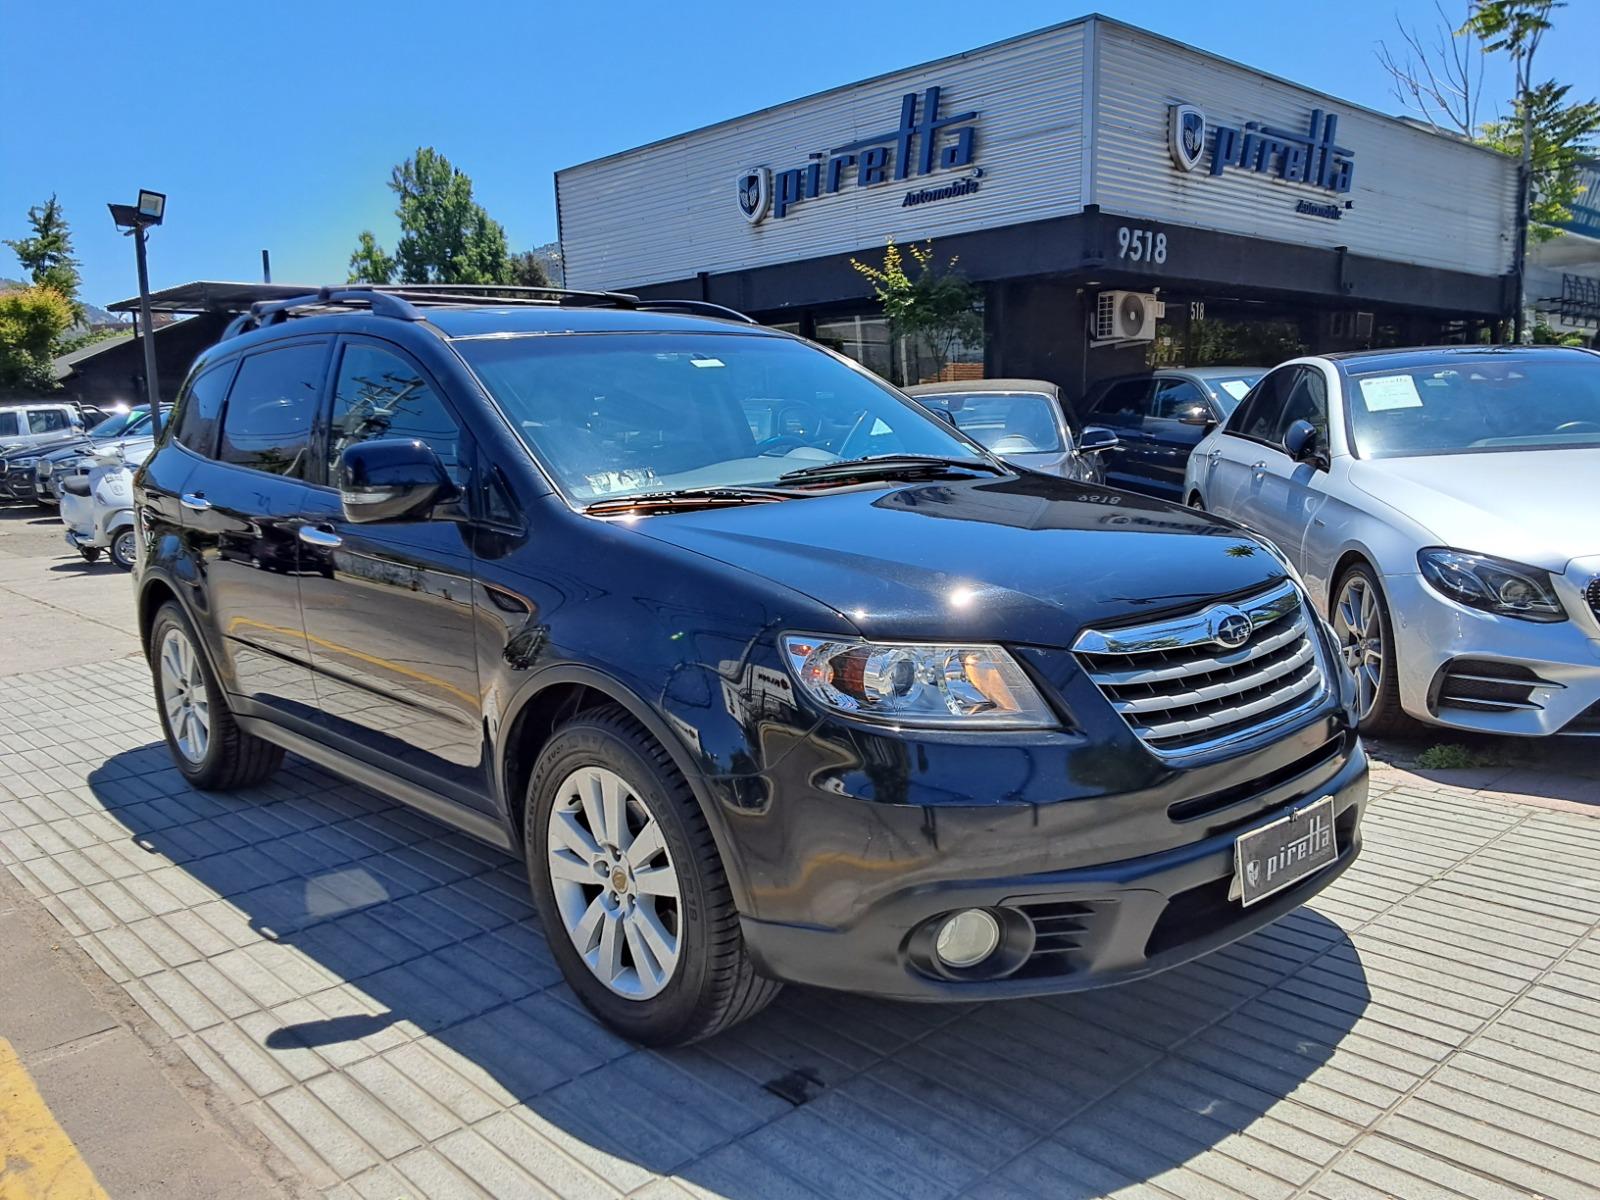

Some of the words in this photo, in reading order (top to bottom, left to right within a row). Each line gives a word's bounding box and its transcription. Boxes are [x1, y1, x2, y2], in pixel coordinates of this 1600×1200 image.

[774, 86, 978, 219] piretta
[902, 178, 979, 207] Automobile
[1118, 226, 1167, 264] 9518
[1190, 301, 1205, 320] 518
[1267, 815, 1330, 881] piretta
